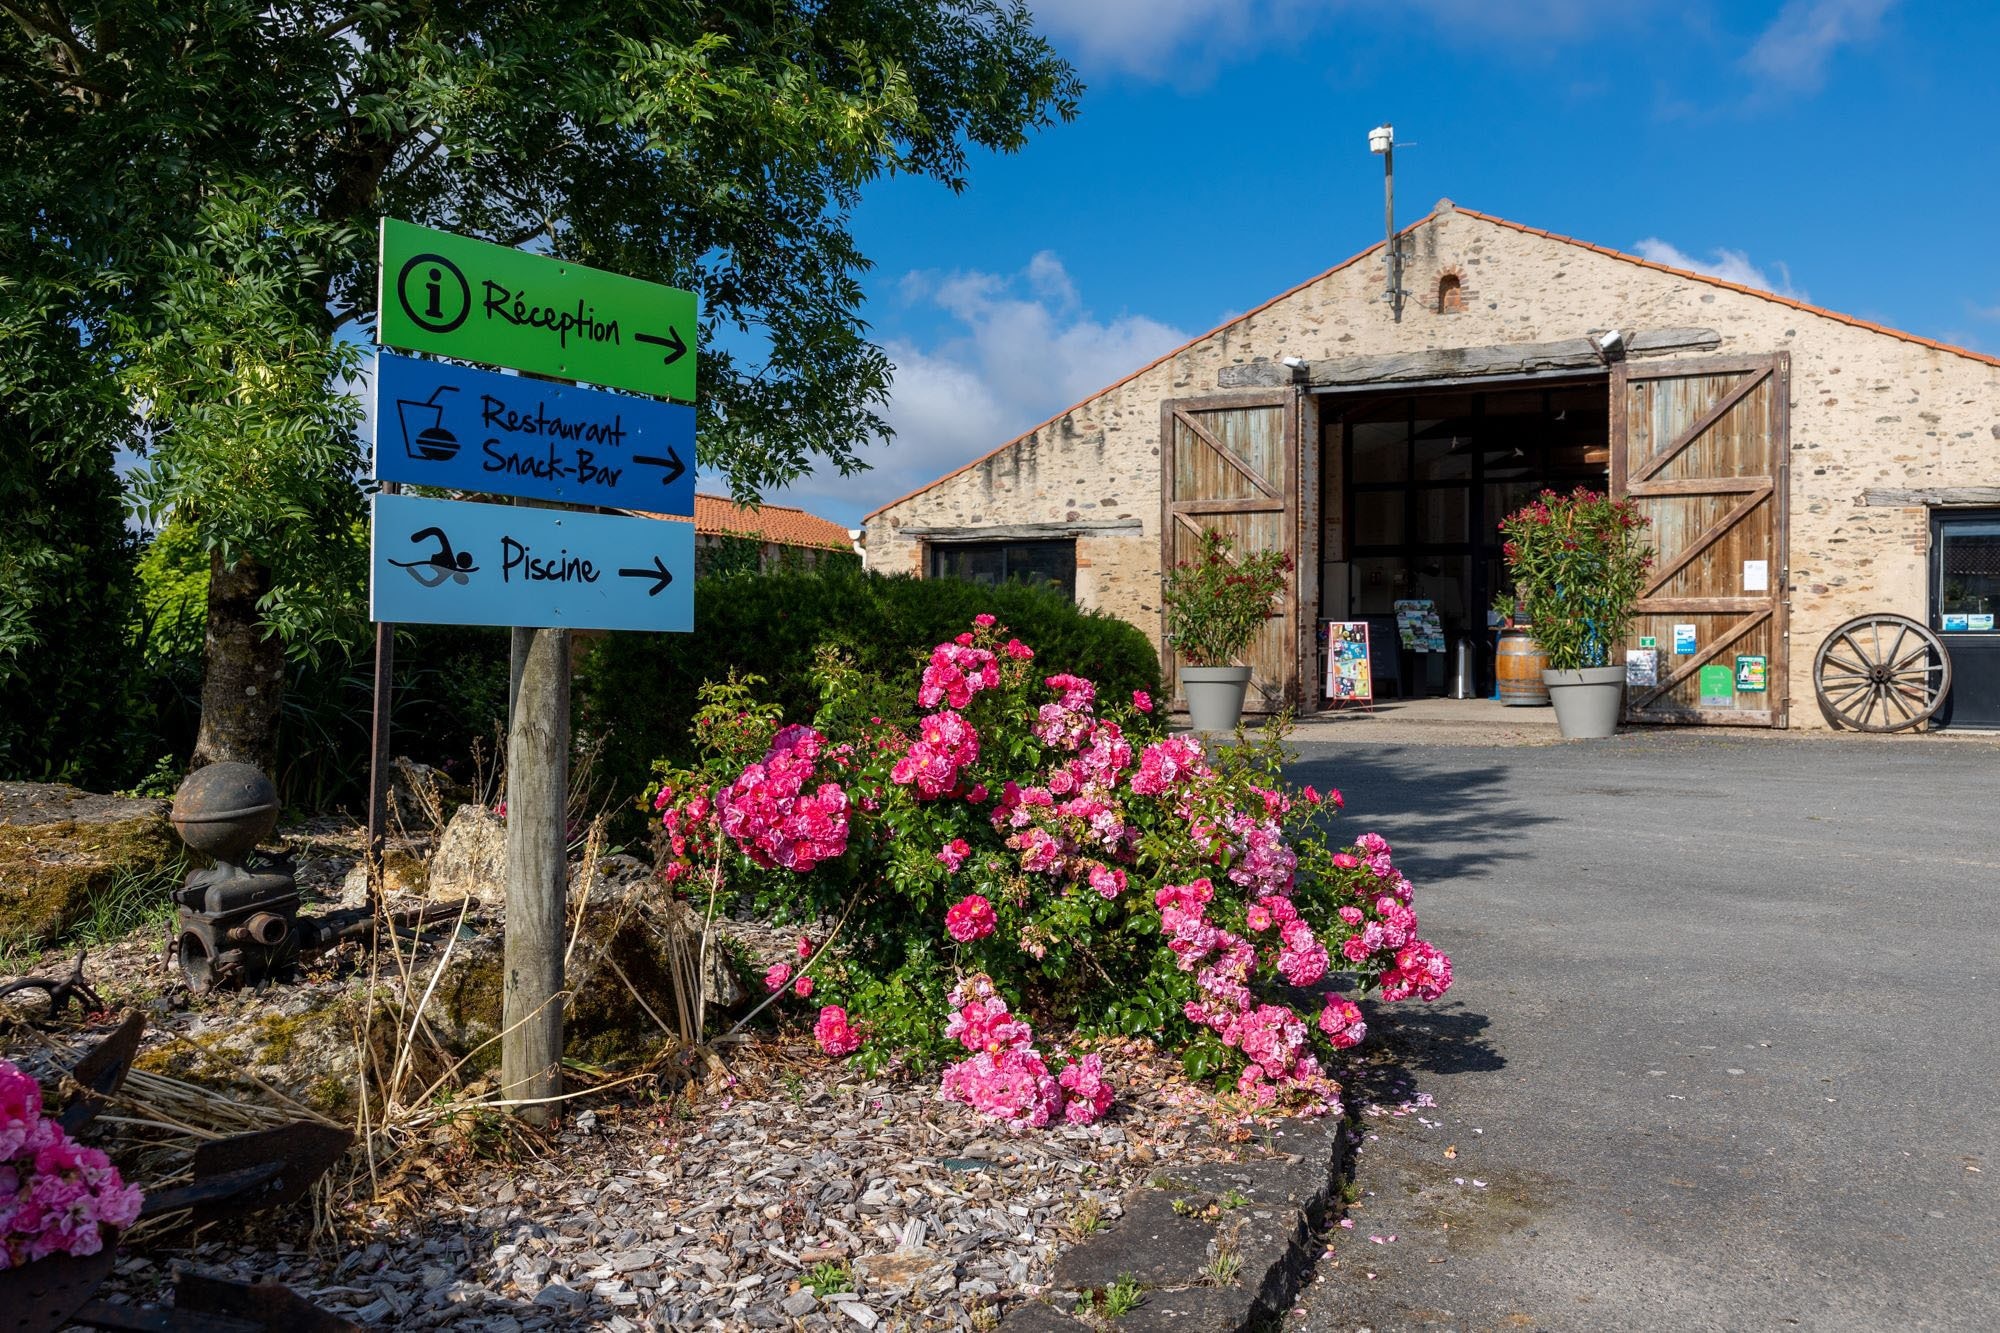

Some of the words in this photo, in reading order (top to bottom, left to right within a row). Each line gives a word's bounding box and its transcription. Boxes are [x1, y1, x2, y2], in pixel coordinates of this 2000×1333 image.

[481, 279, 620, 348] Réception
[480, 394, 627, 447] Restaurant
[482, 438, 623, 488] Snack-Bar
[501, 535, 601, 584] Piscine
